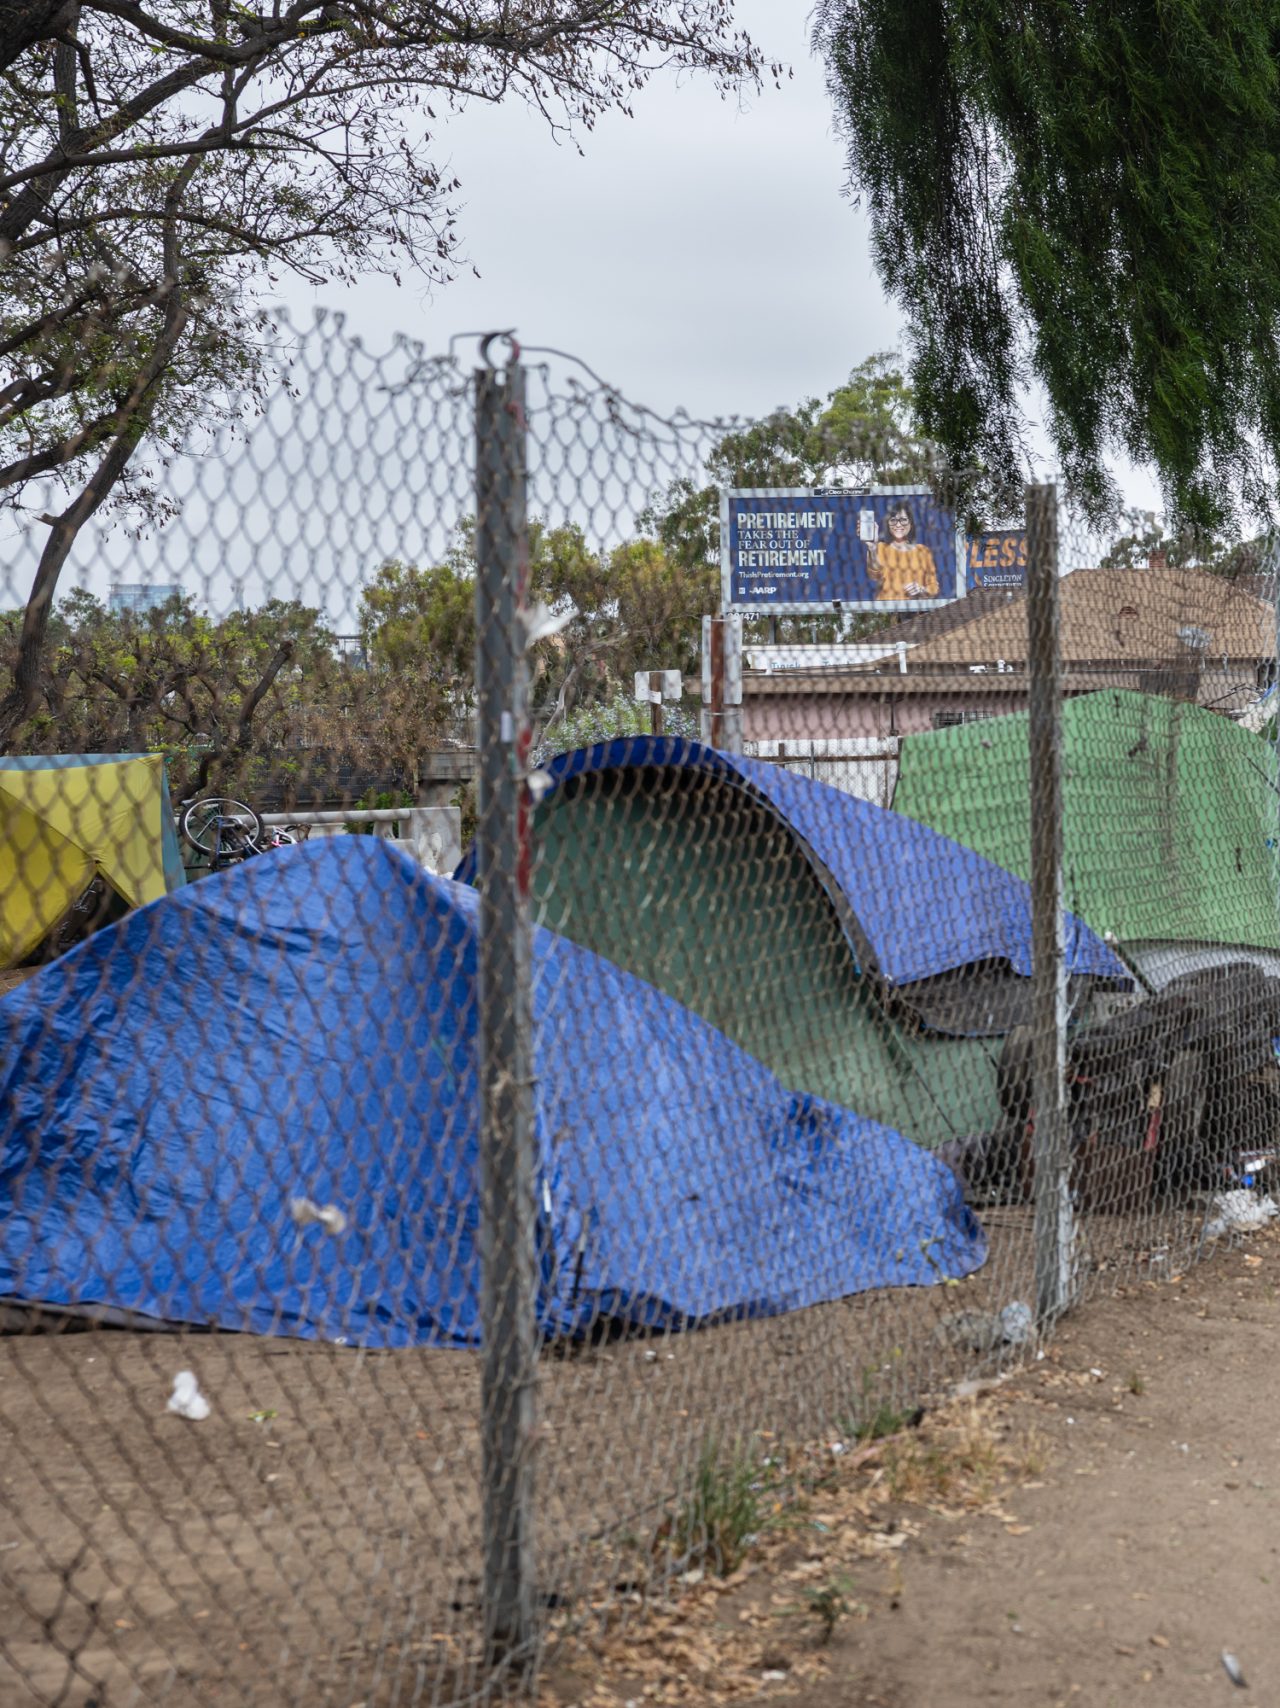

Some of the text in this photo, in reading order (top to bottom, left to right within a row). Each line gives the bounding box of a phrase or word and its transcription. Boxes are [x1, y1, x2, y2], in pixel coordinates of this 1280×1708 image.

[737, 511, 834, 529] PRETIREMENT
[738, 529, 799, 539] TAKES THE
[739, 539, 810, 549] FEAR OUT OF
[738, 549, 827, 567] RETIREMENT
[965, 537, 1027, 568] LESS
[752, 586, 777, 594] AARP
